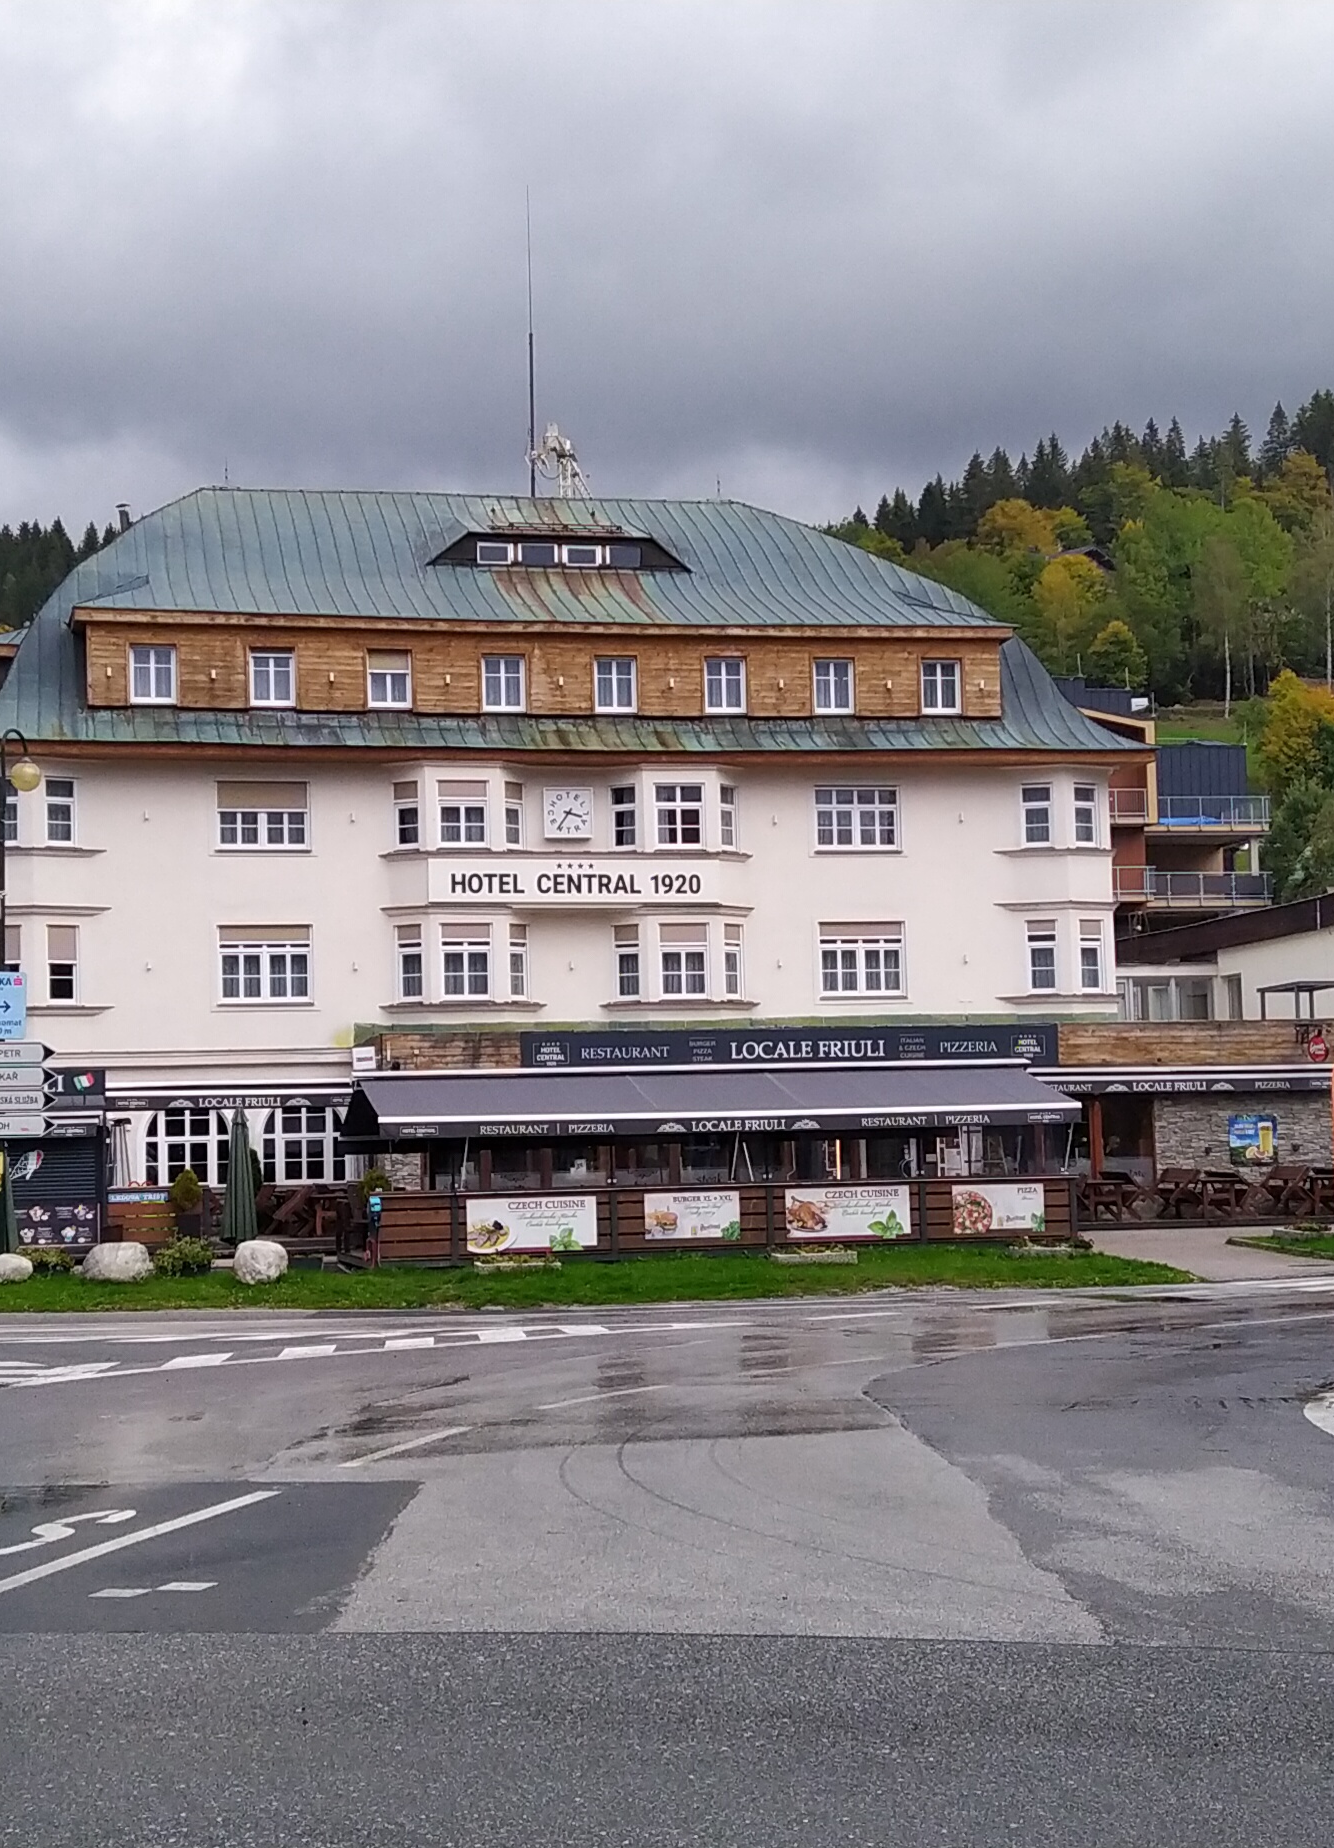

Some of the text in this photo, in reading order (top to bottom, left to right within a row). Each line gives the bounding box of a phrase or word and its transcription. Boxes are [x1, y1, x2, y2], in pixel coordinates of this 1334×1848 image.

[450, 873, 702, 895] HOTEL CENTRAL 1920
[580, 1046, 670, 1059] RESTAURANT
[730, 1040, 885, 1060] LOCALE FRIULI
[940, 1040, 998, 1053] PIZZERIA
[536, 1053, 565, 1061] CENTRAL
[1047, 1081, 1291, 1092] STAURANT LOCALE FRIULI PIZZERIA
[198, 1096, 282, 1108] LOCALE FRIULI
[480, 1114, 991, 1135] RESTAURANT PIZZERIA LOCALE FRIULI RESTAURANT PIZZERIA
[825, 1188, 900, 1200] CZECH CUISINE
[1017, 1187, 1038, 1195] PIZZA
[673, 1195, 702, 1203] BURGER
[703, 1194, 713, 1202] XL
[507, 1199, 586, 1211] CZECH CUISINE
